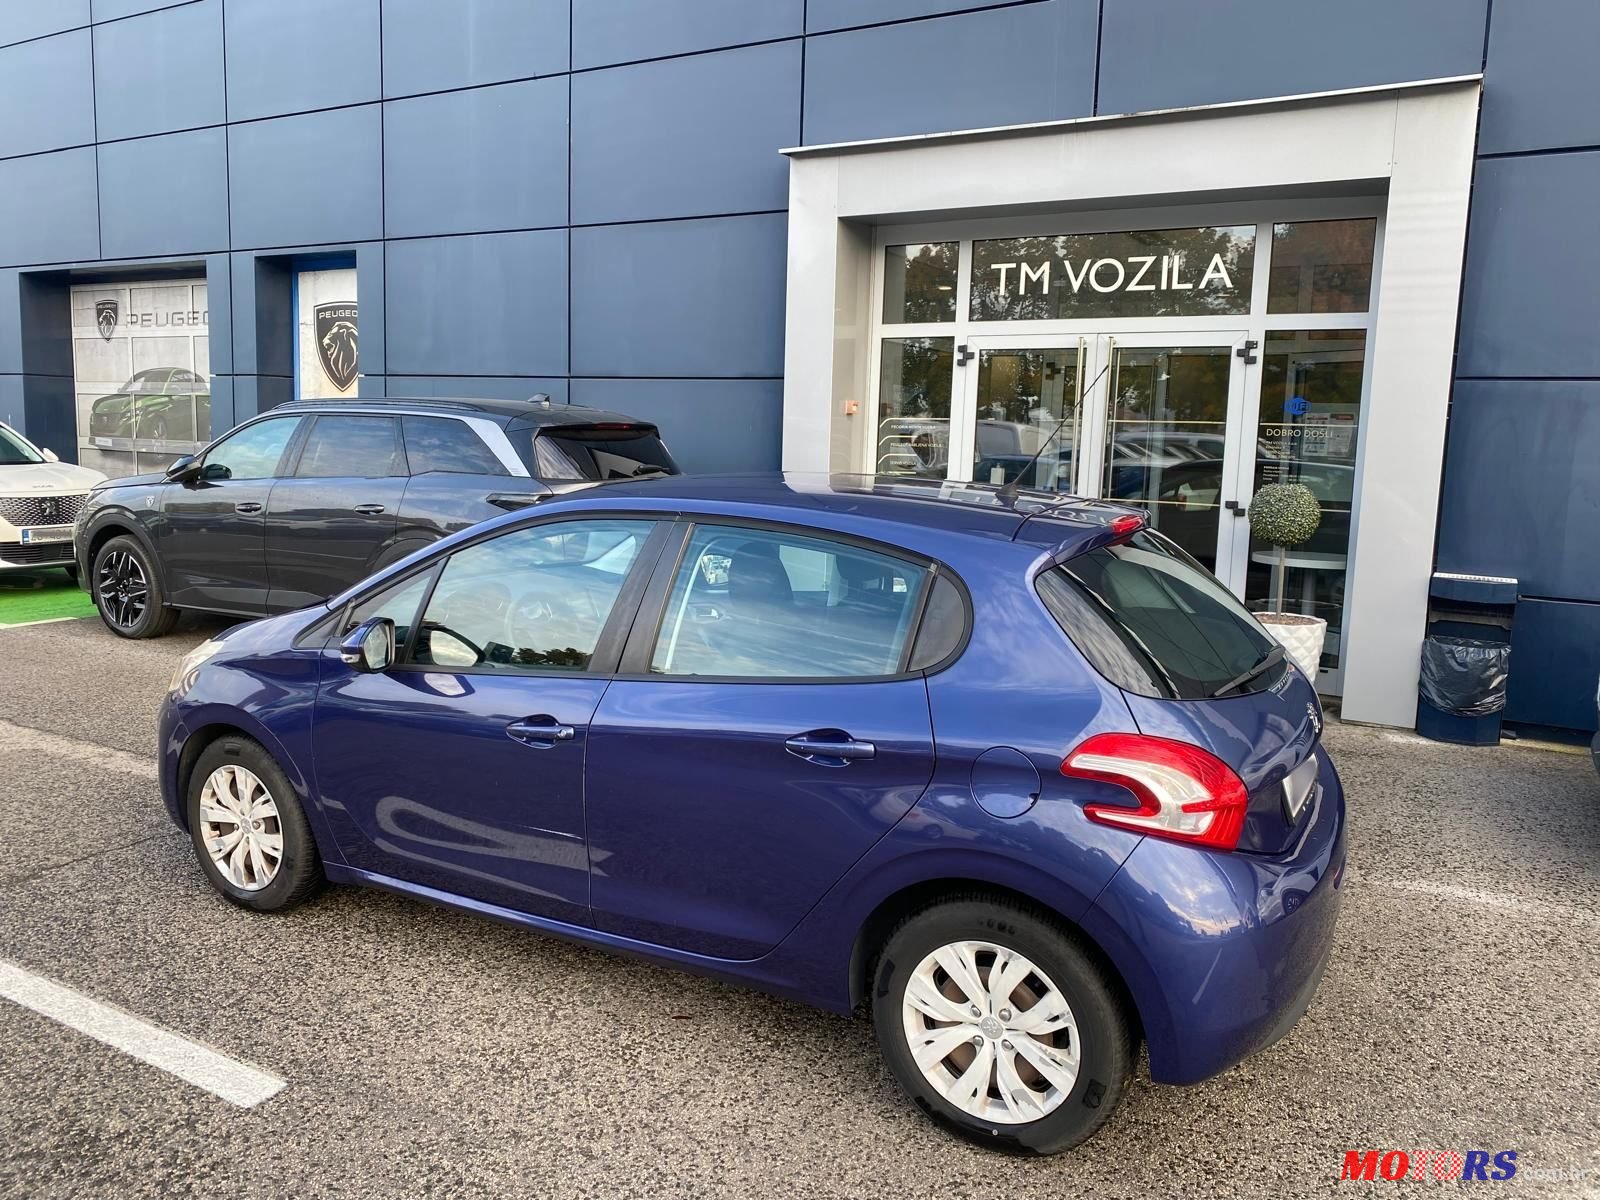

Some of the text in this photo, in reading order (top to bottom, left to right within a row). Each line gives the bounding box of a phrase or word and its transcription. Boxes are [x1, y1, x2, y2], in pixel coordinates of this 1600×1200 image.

[990, 253, 1234, 296] TM VOZILA
[1266, 428, 1301, 437] DOBRO
